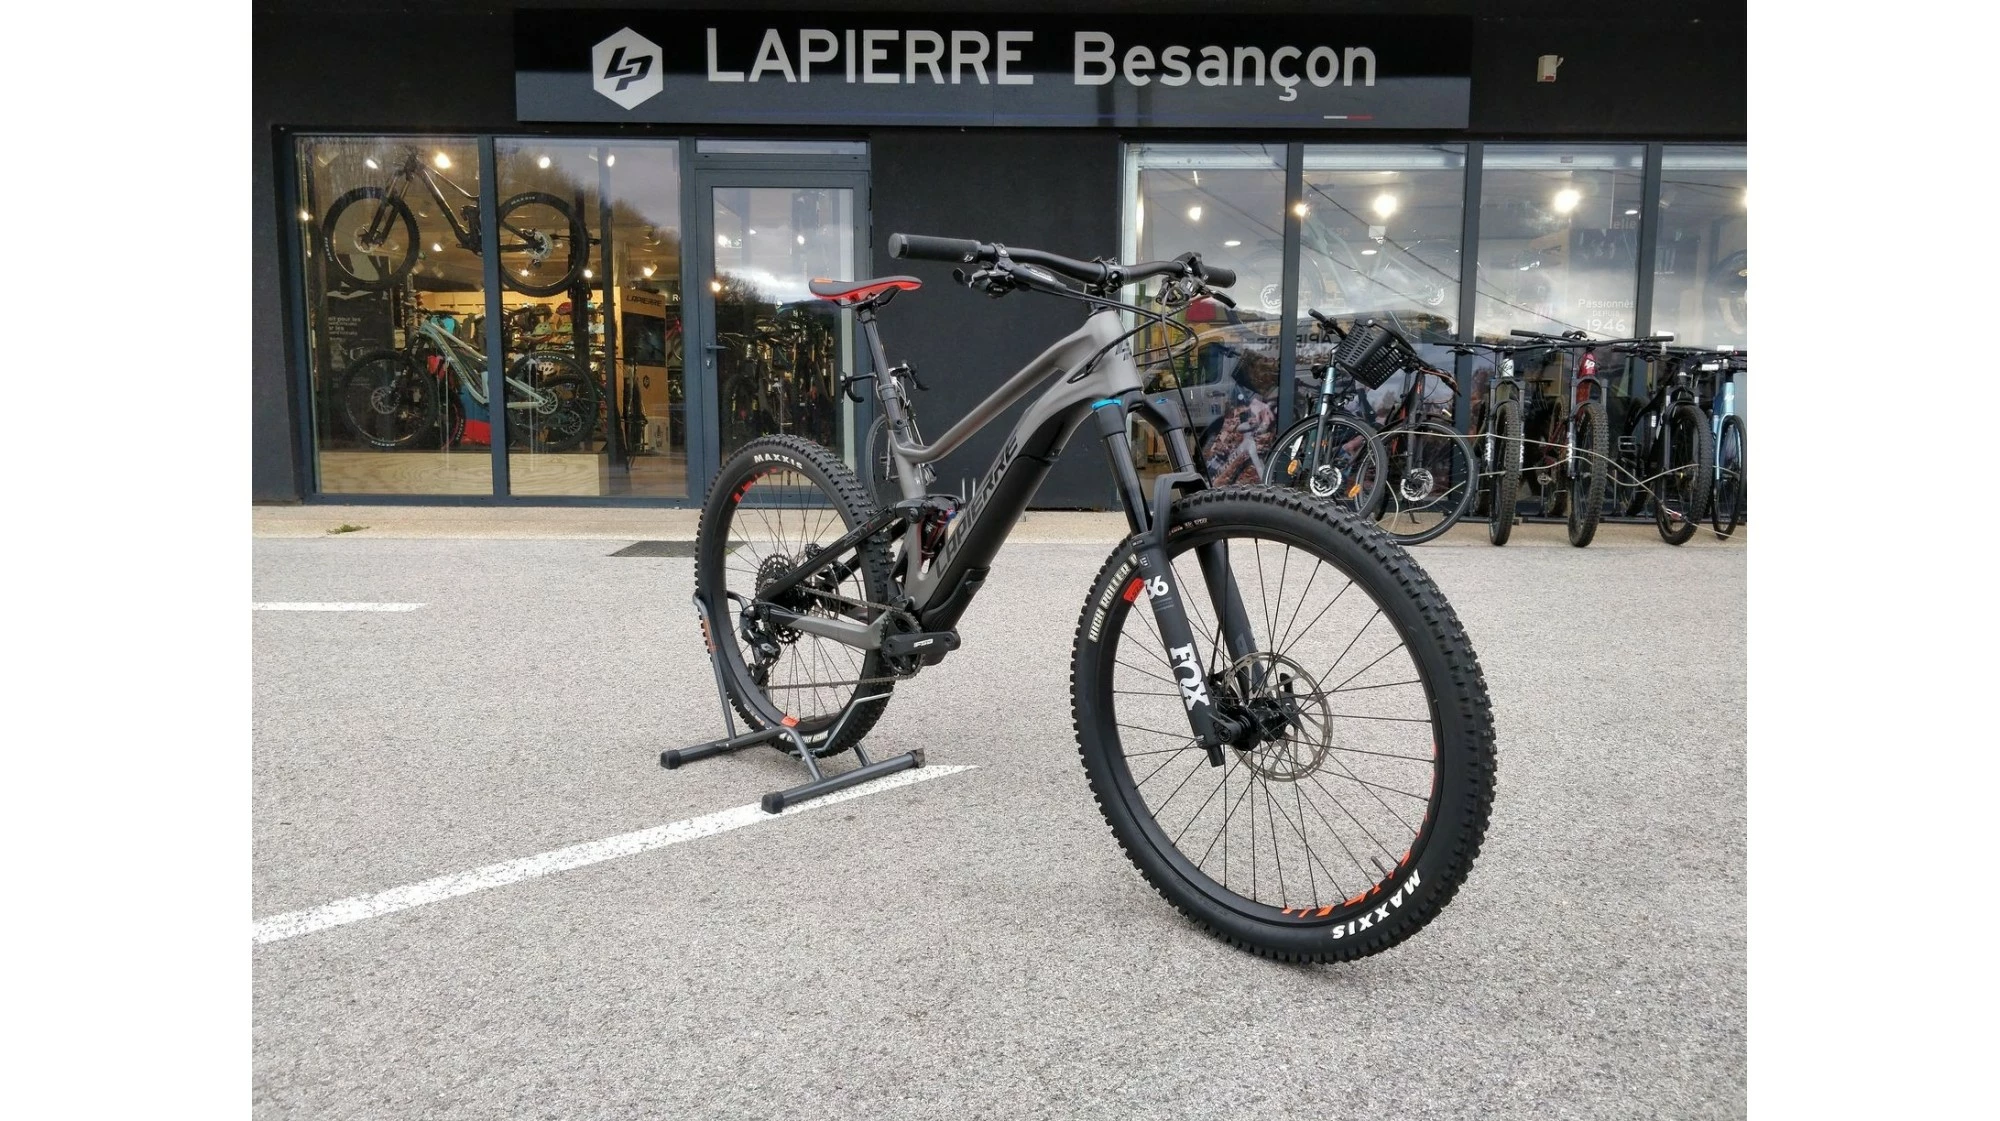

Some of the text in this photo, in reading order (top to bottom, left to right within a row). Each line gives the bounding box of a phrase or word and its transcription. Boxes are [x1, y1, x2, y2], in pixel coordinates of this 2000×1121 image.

[707, 29, 1376, 101] LAPIERRE Besançon
[1587, 319, 1626, 332] 1946
[753, 453, 803, 470] MAXXIS
[935, 430, 1018, 579] LAPIERRE
[1088, 606, 1106, 643] HIGH
[1099, 561, 1132, 610] ROLLER
[1144, 575, 1169, 600] 36
[1170, 642, 1210, 711] FOX
[1332, 868, 1421, 940] MAXXIS
